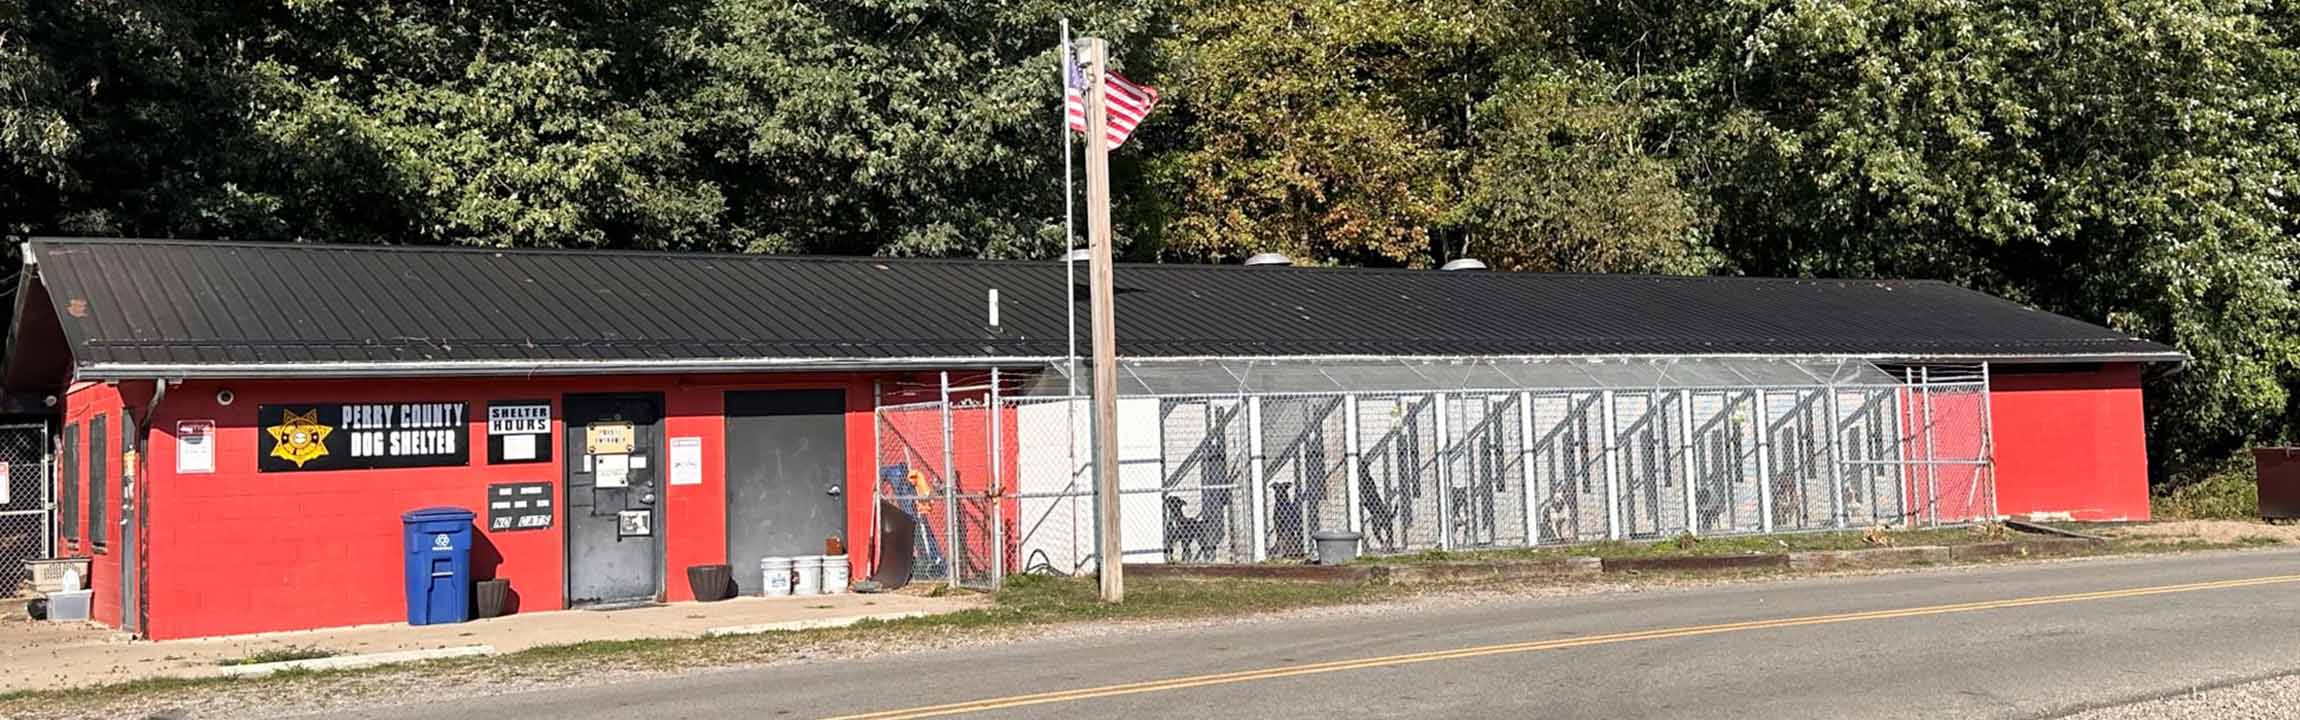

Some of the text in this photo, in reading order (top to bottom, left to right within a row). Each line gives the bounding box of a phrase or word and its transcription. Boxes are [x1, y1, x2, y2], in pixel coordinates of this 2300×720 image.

[342, 403, 464, 429] PERRY COUNTY
[492, 407, 547, 418] SHELTER
[494, 419, 546, 431] HOURS
[351, 430, 456, 457] DOG SHELTER
